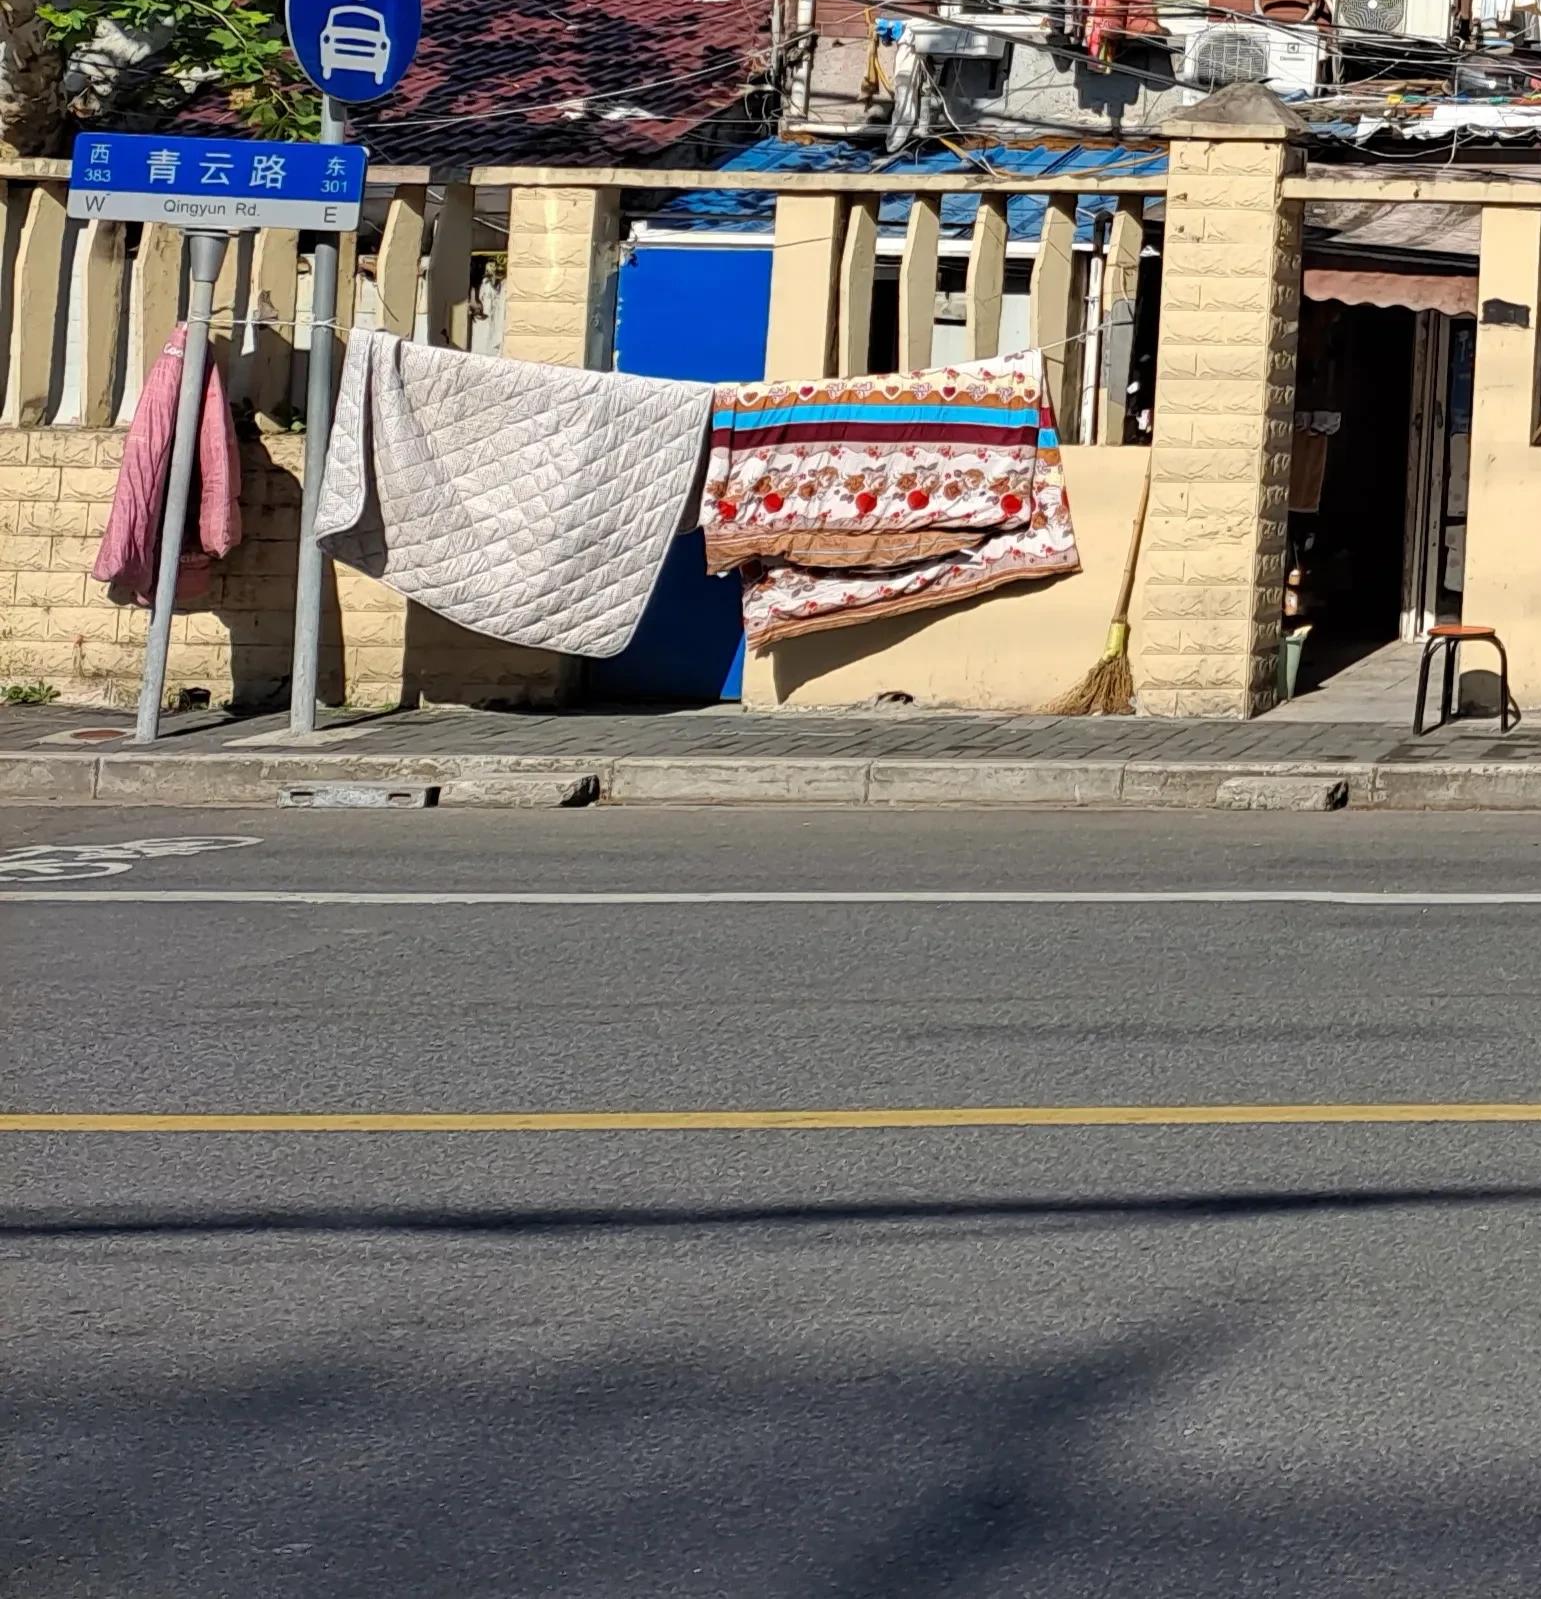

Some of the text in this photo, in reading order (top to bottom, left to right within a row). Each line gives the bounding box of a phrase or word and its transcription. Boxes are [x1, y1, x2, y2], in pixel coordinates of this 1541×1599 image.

[90, 143, 112, 165] 西
[146, 149, 287, 189] 青云路
[325, 156, 348, 177] 东
[84, 168, 112, 183] 383
[321, 179, 348, 193] 301
[85, 195, 106, 212] W
[163, 199, 260, 217] Qingyun Rd.
[324, 206, 338, 223] E
